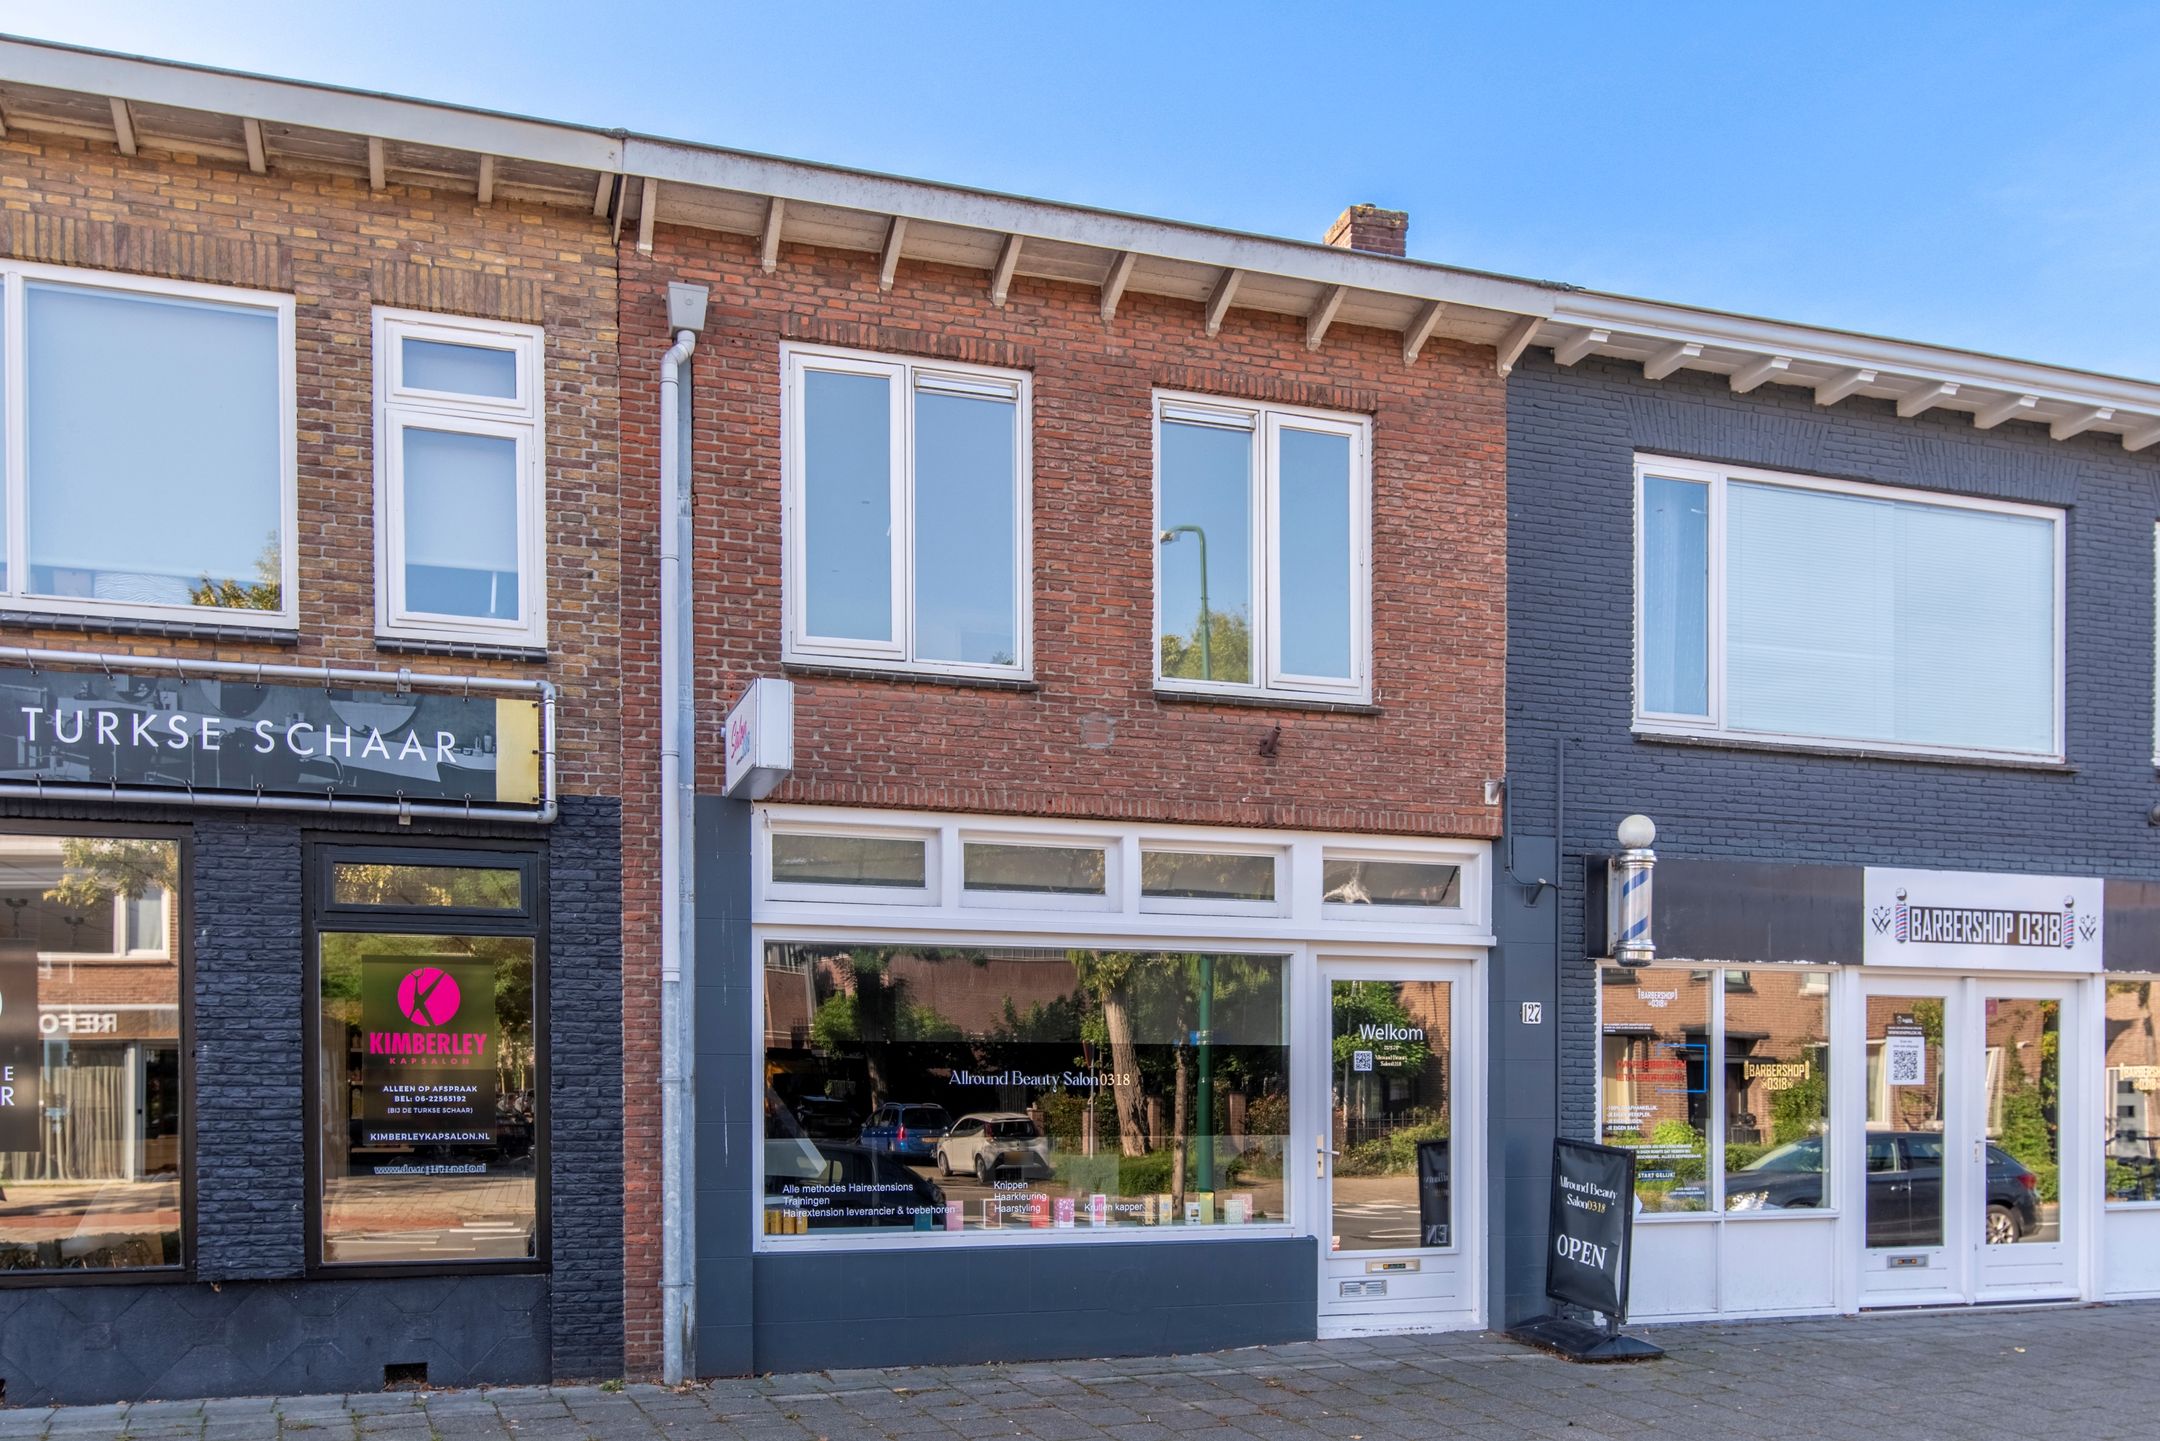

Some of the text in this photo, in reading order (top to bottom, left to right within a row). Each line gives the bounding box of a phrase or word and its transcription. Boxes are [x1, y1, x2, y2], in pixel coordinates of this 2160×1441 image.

[21, 707, 457, 763] TURKSE SCHAAR
[1911, 908, 2061, 946] BARBERSHOP 0318
[1523, 1003, 1541, 1023] 127
[1359, 1023, 1423, 1041] Welkom
[369, 1032, 487, 1055] KIMBERLEY
[389, 1057, 470, 1065] KAPSALON
[1749, 1063, 1805, 1078] BARBERSHOP
[949, 1070, 1008, 1085] Allround
[1012, 1070, 1060, 1093] Beauty
[1767, 1077, 1788, 1091] 0318
[394, 1095, 413, 1103] BEL:
[370, 1132, 490, 1141] KIMBERLEYKAPSALON.NL
[782, 1183, 914, 1194] Alle methodes Hairextensions
[993, 1181, 1029, 1191] Knippen
[994, 1192, 1047, 1202] Haarkleuring
[1590, 1182, 1617, 1206] Beauty
[783, 1196, 831, 1208] Trainingen
[1084, 1202, 1143, 1213] Krullen kapper
[783, 1208, 844, 1218] Hairextension
[846, 1207, 895, 1217] leverancier
[906, 1205, 956, 1215] toebehoren
[994, 1204, 1041, 1214] Haarstyling
[1557, 1234, 1608, 1270] OPEN
